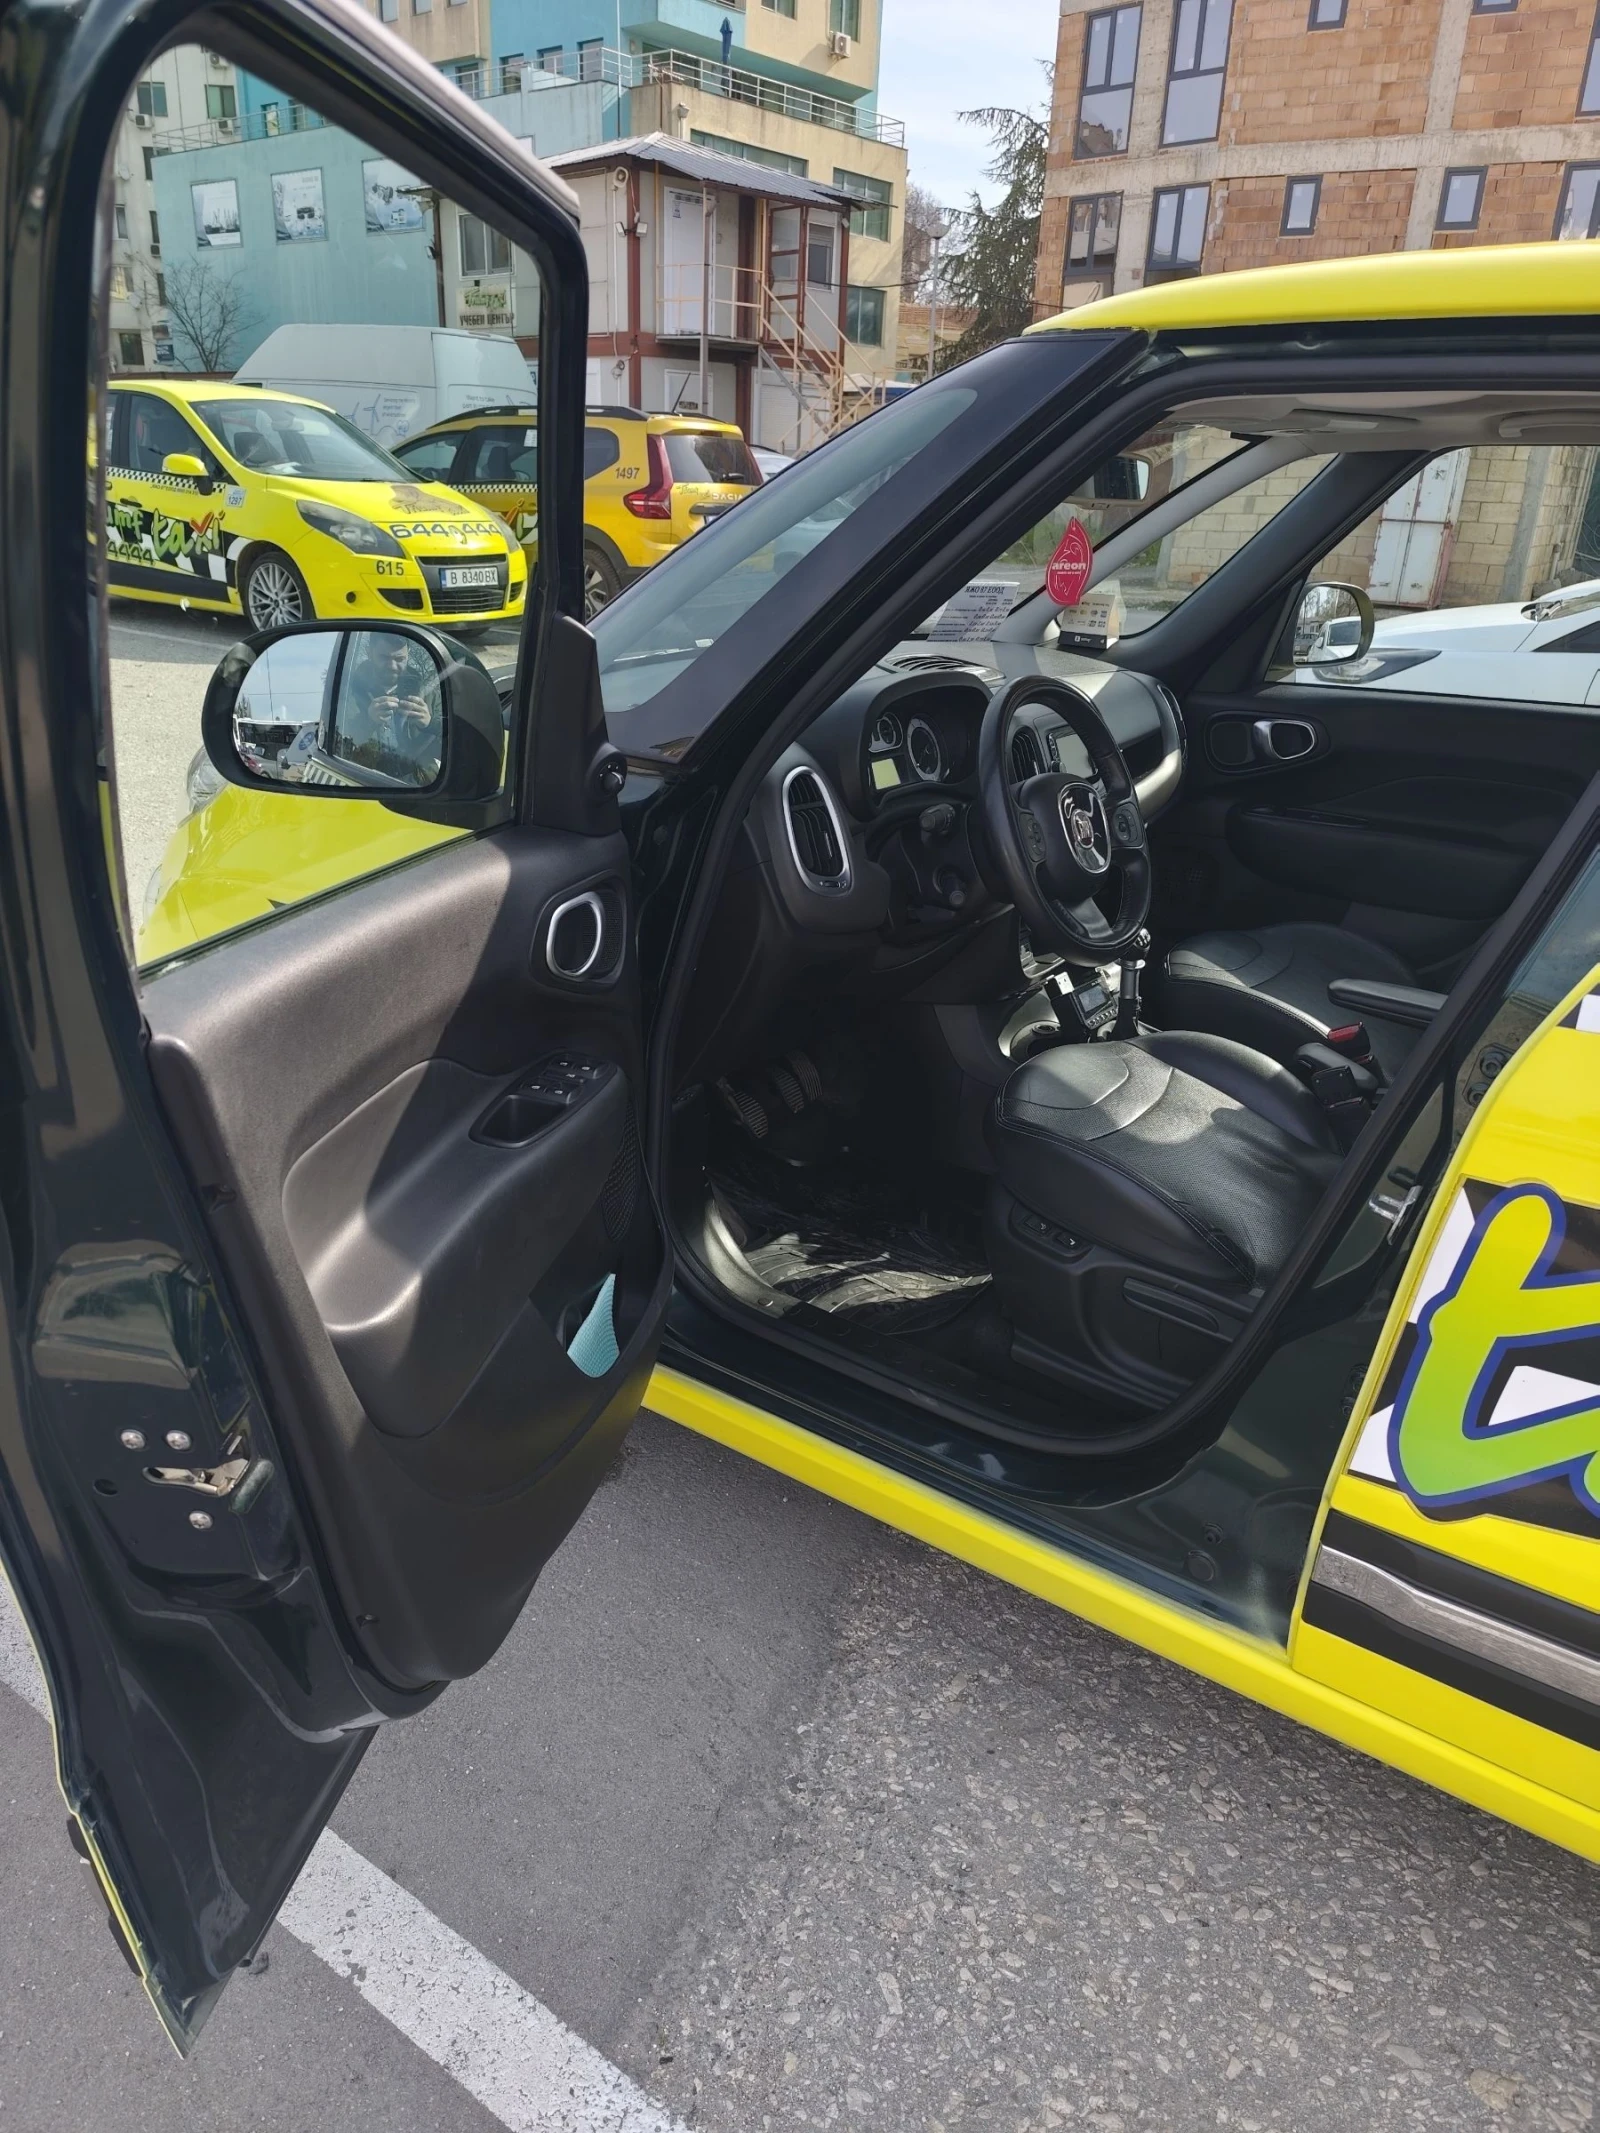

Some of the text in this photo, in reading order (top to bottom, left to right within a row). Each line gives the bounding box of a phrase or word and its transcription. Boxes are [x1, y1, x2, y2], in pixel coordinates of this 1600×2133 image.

[615, 467, 640, 479] 1497
[389, 523, 502, 539] 644 444
[376, 560, 404, 576] 615
[1052, 562, 1087, 570] areon
[451, 572, 457, 585] B
[462, 571, 484, 584] 8340
